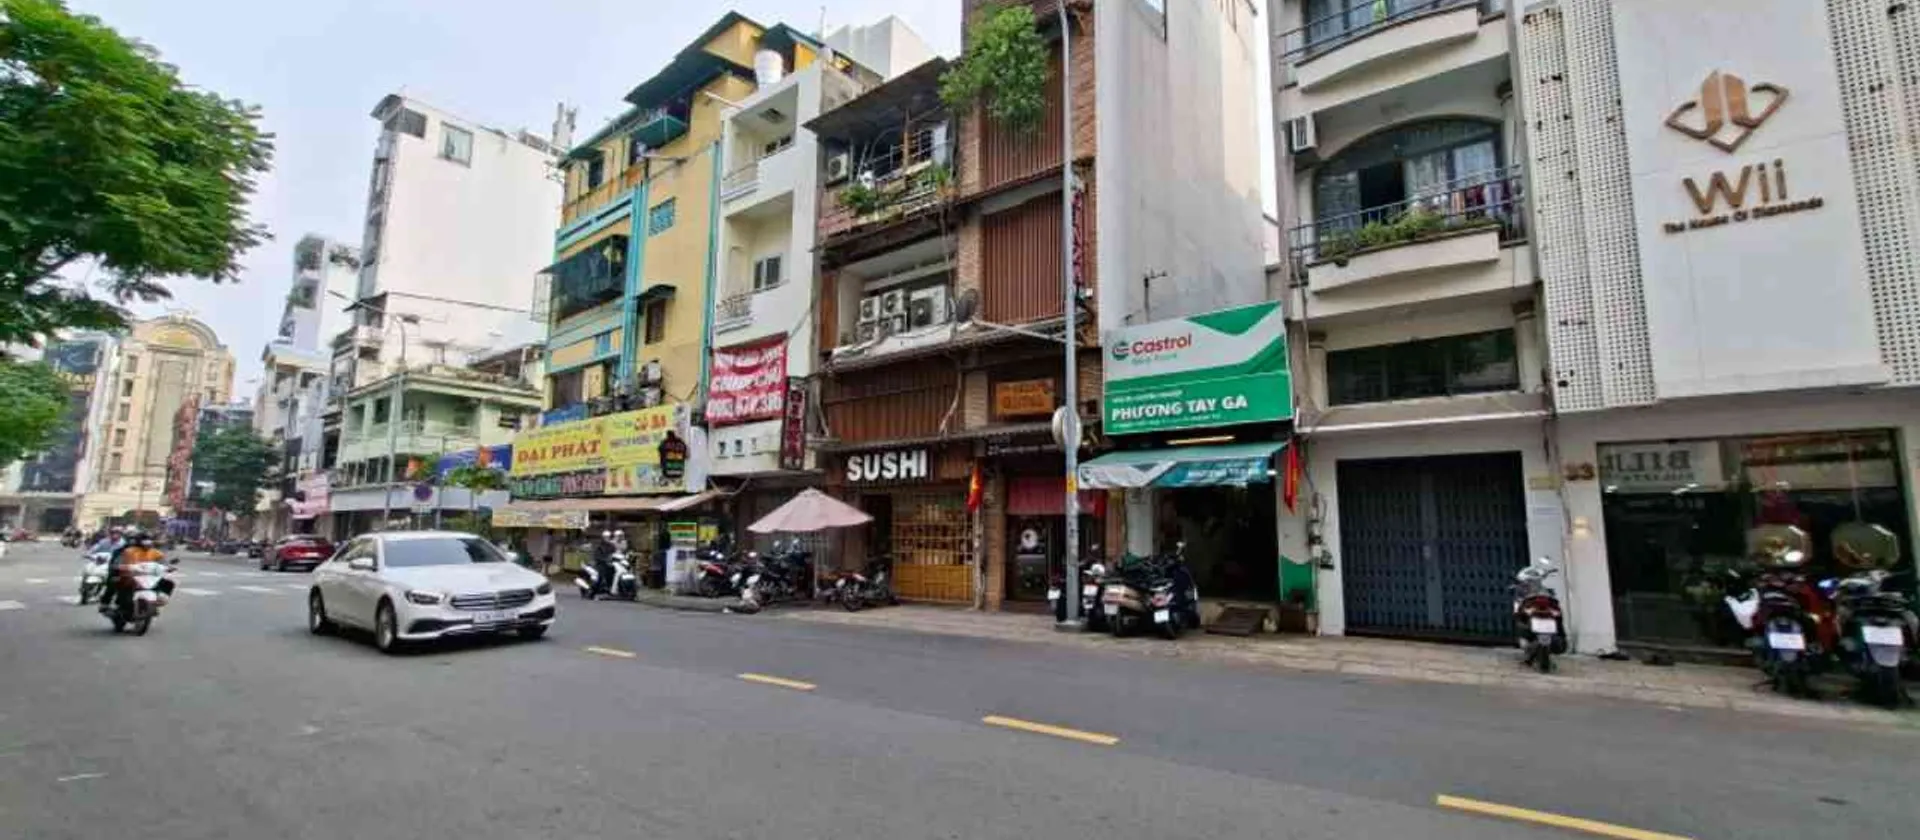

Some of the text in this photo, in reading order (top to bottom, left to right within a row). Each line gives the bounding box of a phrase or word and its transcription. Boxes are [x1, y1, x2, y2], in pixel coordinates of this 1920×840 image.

[1682, 158, 1788, 215] Wii
[1663, 221, 1686, 234] The
[1689, 215, 1729, 230] House
[1752, 196, 1824, 218] Diamonds
[1132, 334, 1192, 355] Castrol
[1111, 394, 1248, 421] PHƯƠNG TAY GA
[847, 450, 927, 482] SUSHI
